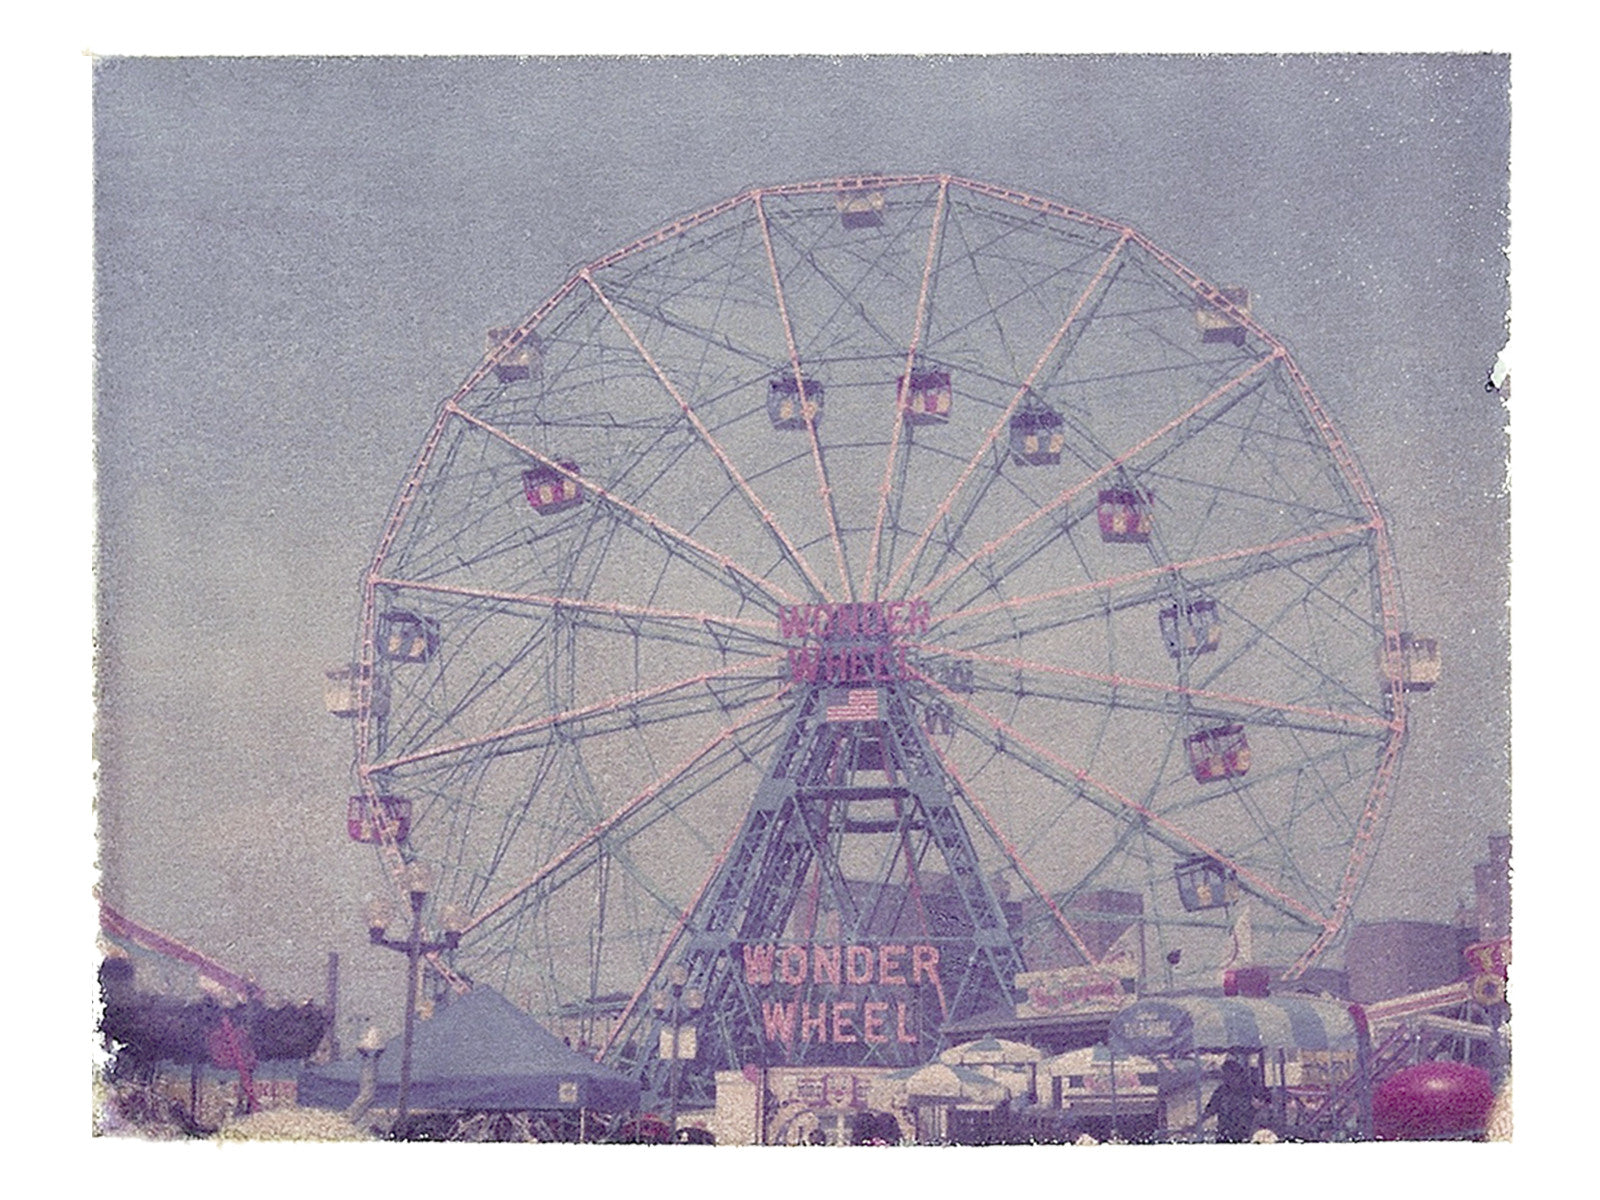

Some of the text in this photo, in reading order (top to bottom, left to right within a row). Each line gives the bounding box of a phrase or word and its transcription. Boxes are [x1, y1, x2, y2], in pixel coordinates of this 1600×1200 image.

[779, 601, 930, 638] WONDER
[788, 649, 919, 684] WHEEL
[743, 945, 940, 985] WONDER
[762, 1001, 917, 1043] WHEEL
